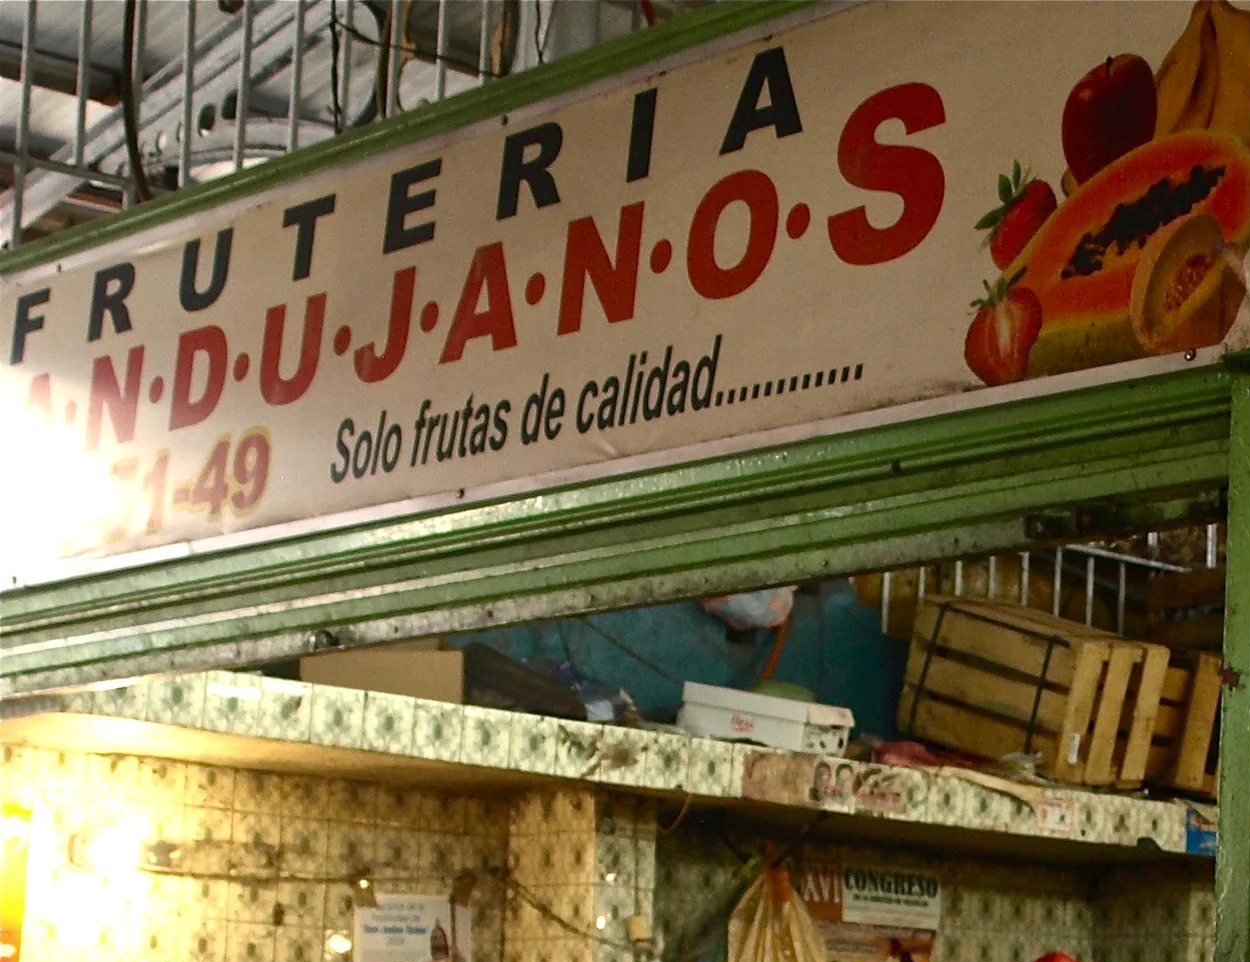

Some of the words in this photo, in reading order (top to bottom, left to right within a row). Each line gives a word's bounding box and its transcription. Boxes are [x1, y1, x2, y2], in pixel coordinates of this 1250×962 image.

[330, 411, 402, 483] Solo
[410, 392, 511, 466] frutas
[520, 373, 564, 443] de
[843, 870, 938, 899] CONGRESO
